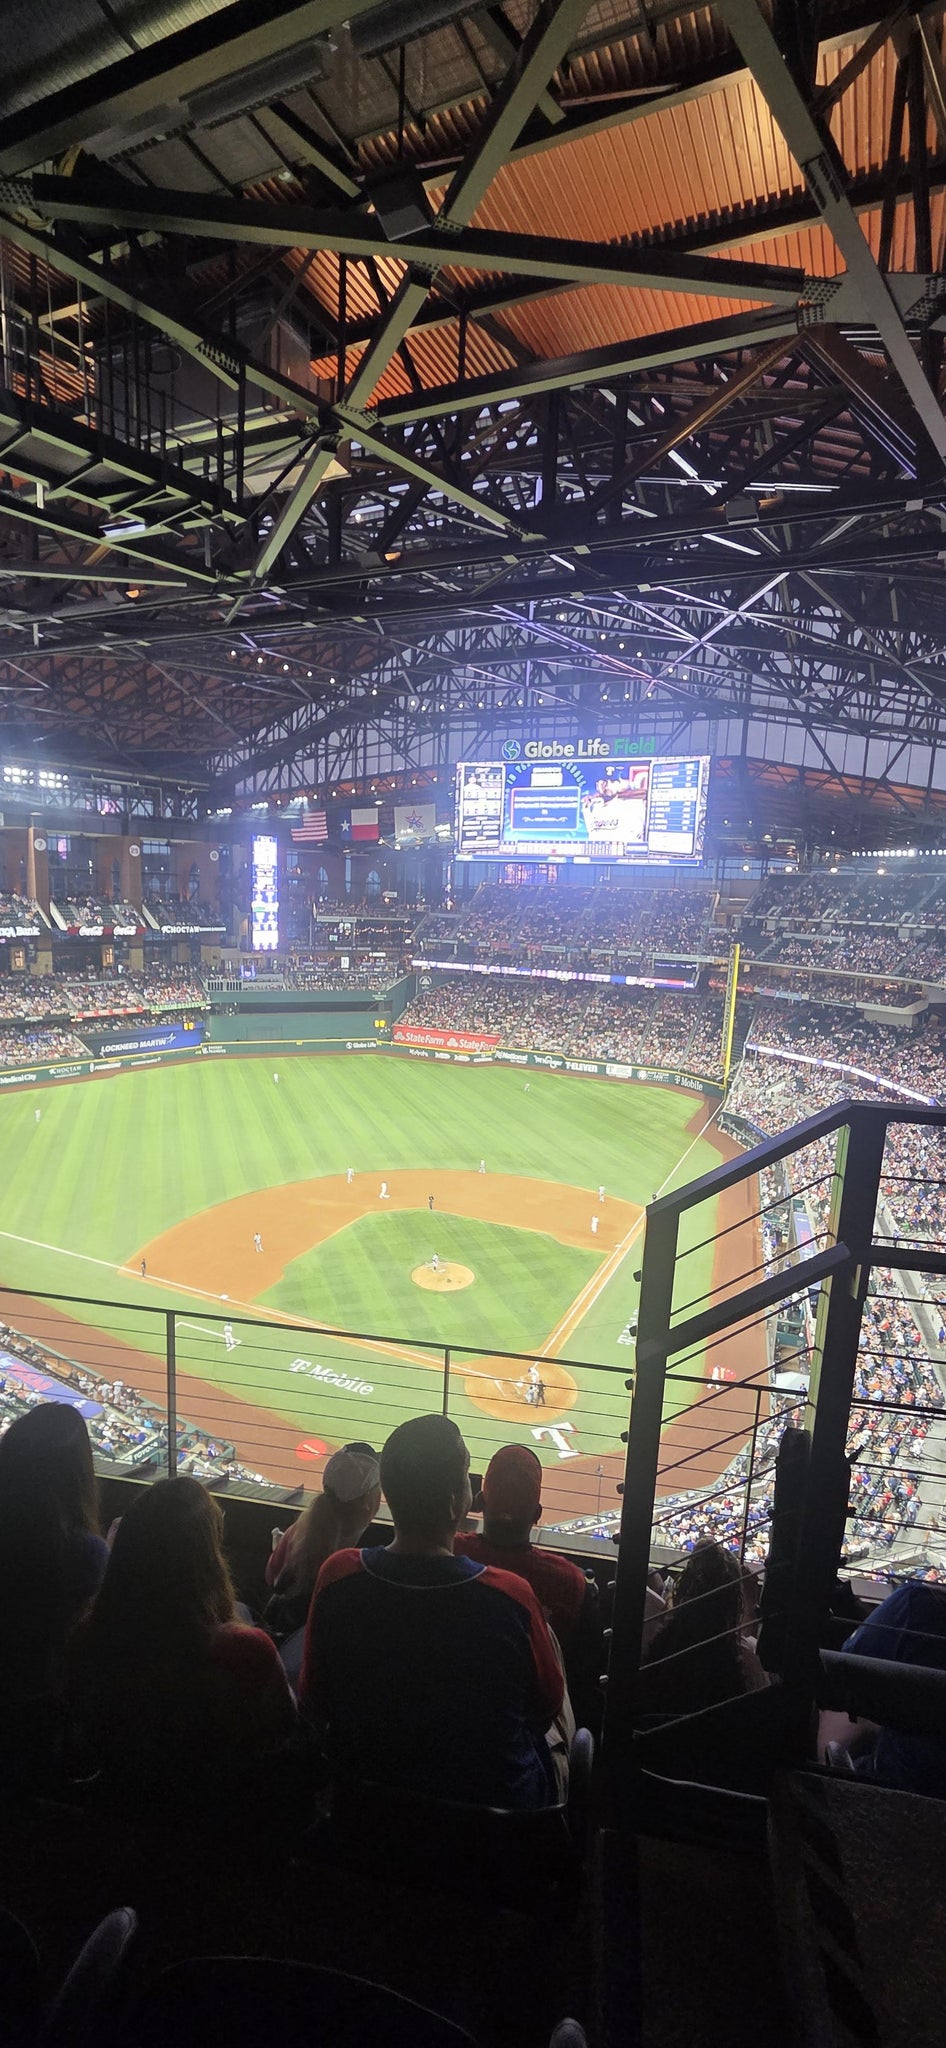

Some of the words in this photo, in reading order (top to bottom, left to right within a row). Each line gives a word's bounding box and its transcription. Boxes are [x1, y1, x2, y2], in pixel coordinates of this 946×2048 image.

[524, 740, 575, 758] Globe
[577, 738, 610, 756] Life
[613, 736, 656, 755] Field
[101, 1042, 139, 1052] LOCKHEED
[140, 1038, 166, 1048] MARTIN
[681, 1076, 703, 1091] Mobile
[306, 1364, 374, 1395] Mobile
